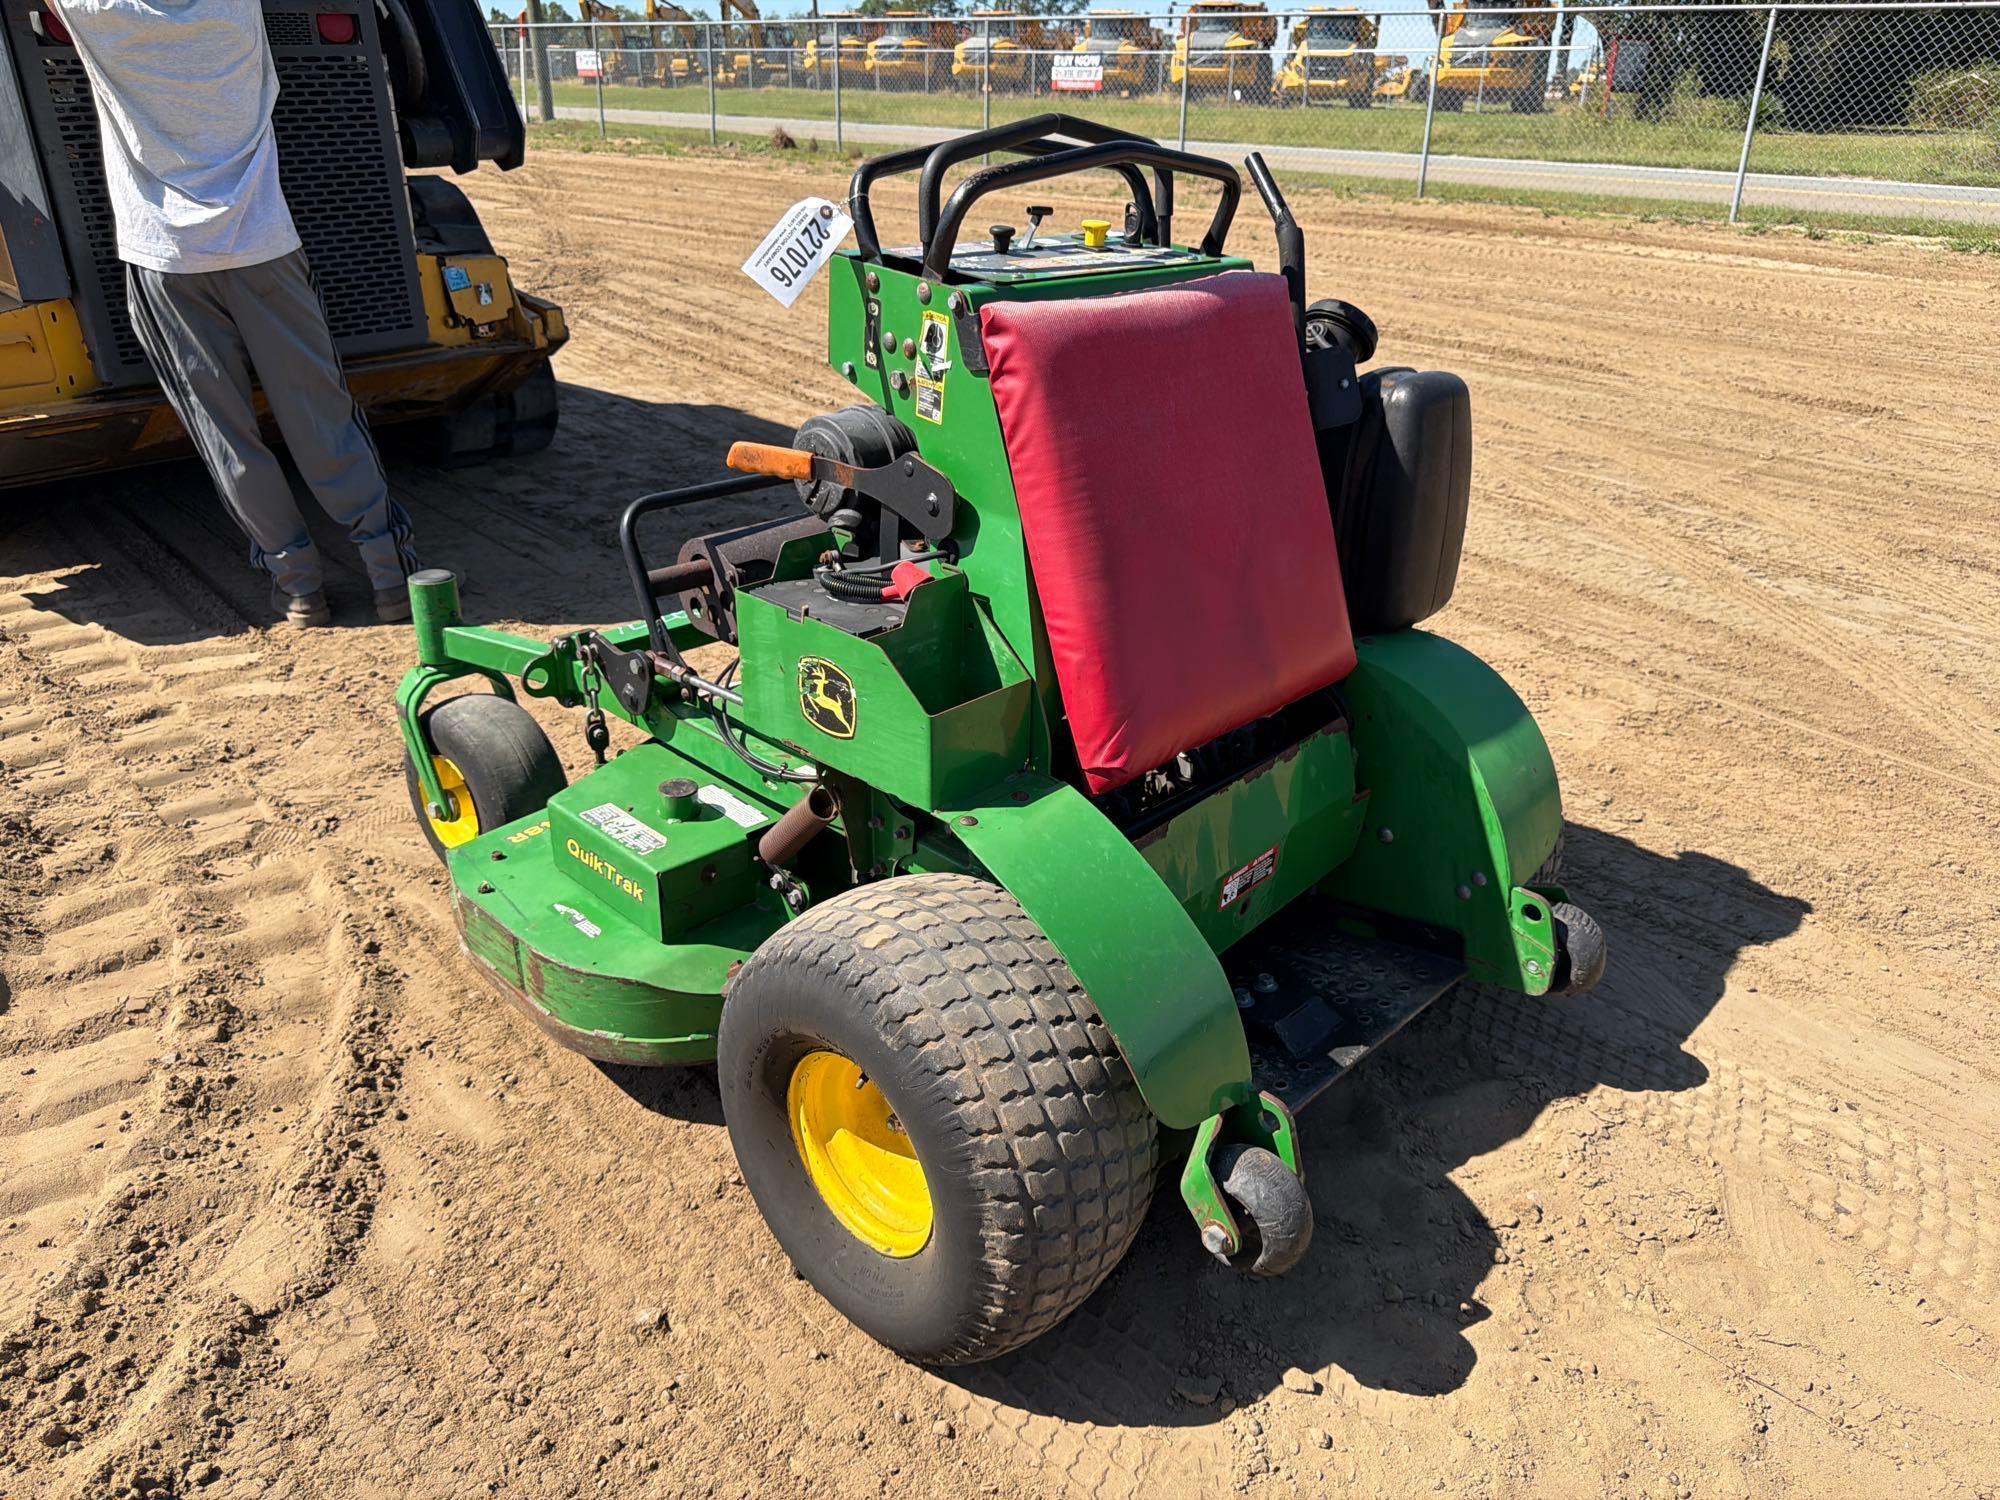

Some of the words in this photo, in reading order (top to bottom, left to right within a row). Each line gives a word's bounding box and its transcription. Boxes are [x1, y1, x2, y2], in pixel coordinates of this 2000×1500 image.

[1054, 55, 1074, 66] BUY
[1075, 55, 1101, 66] NOW
[780, 226, 797, 246] AUCTION
[763, 245, 782, 267] COMPANY
[770, 217, 831, 287] 227076
[566, 838, 645, 902] QuikTrak
